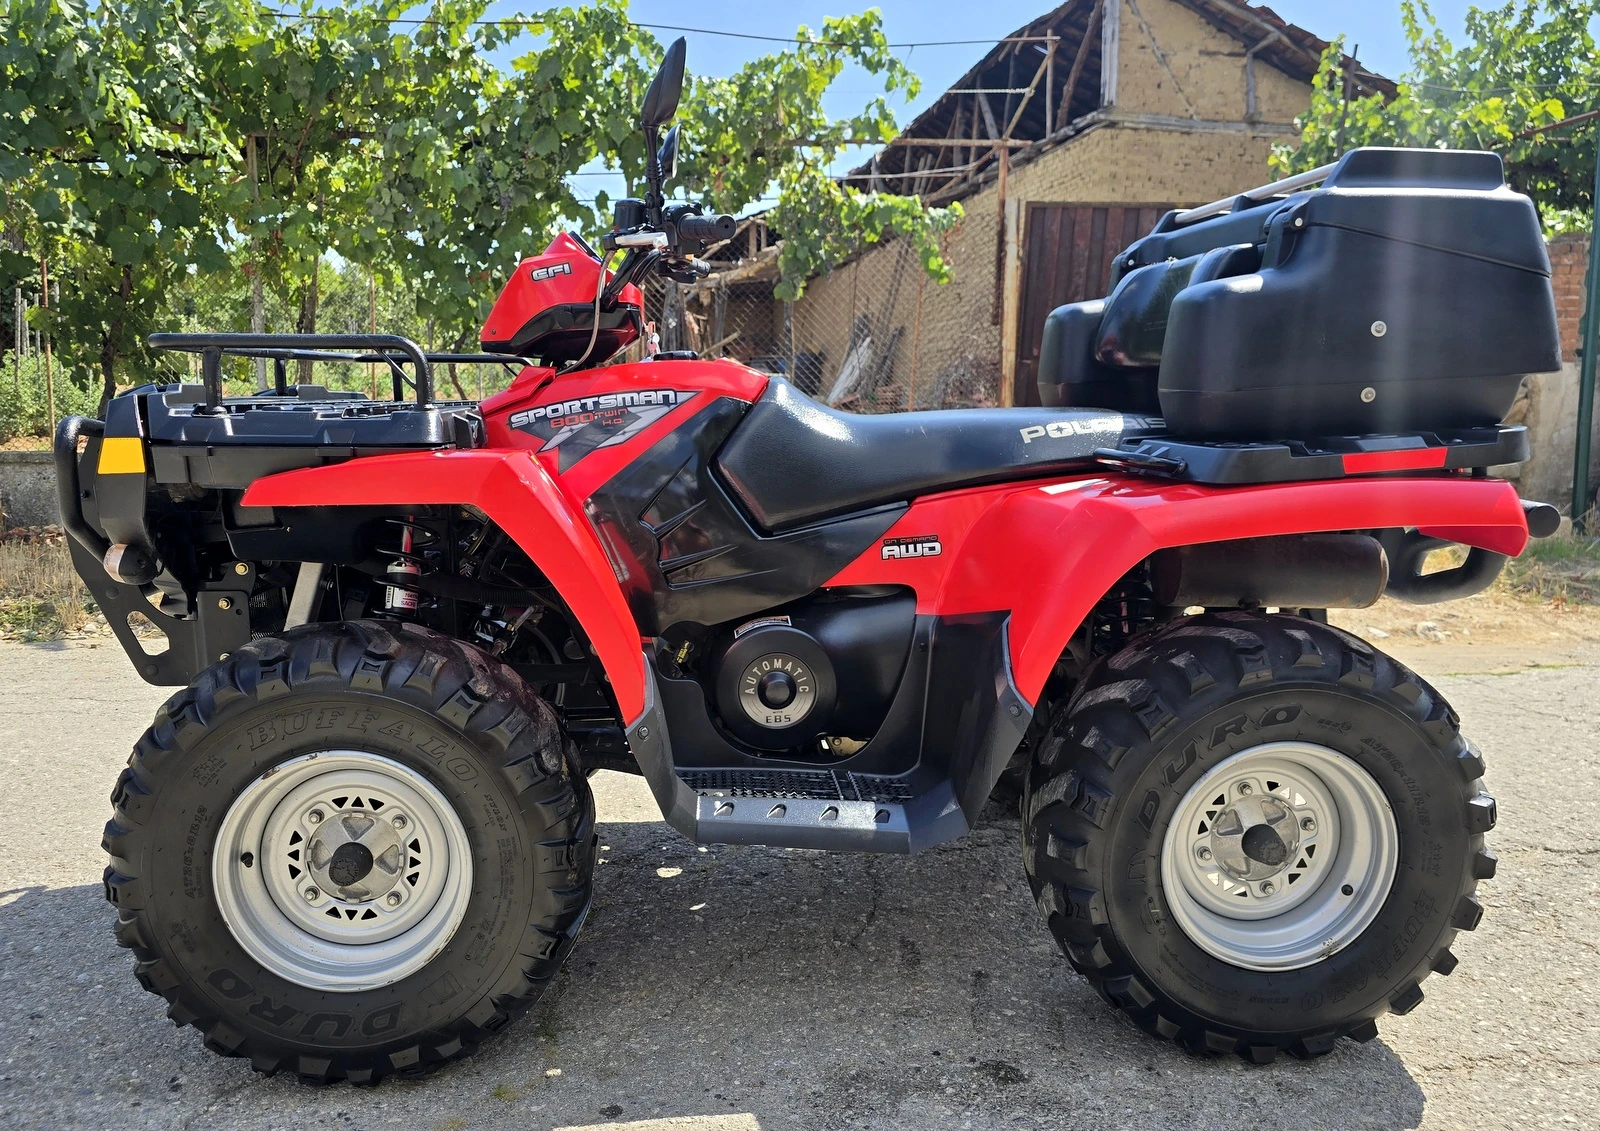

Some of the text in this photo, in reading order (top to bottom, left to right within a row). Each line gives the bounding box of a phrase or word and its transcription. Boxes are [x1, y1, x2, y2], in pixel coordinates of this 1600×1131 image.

[531, 263, 571, 282] EFI
[510, 390, 676, 428] SPORTSMAN
[549, 408, 628, 429] 800 TWIN
[882, 541, 942, 560] AWD
[744, 658, 810, 695] AUTOMATIC
[765, 715, 791, 724] EBS
[247, 706, 480, 784] BUFFALO
[1135, 703, 1304, 835] DURO
[206, 965, 400, 1043] DURO
